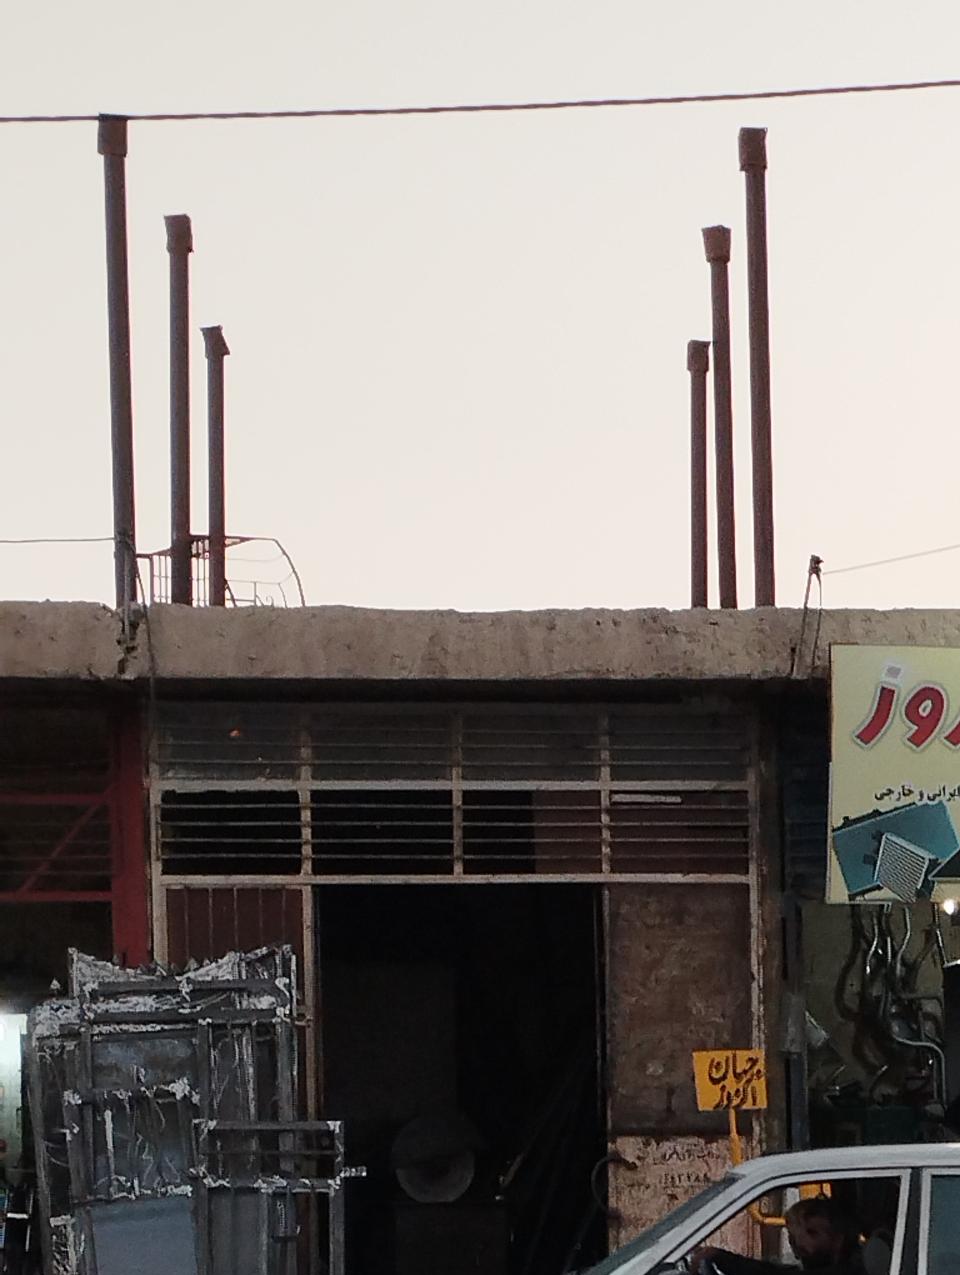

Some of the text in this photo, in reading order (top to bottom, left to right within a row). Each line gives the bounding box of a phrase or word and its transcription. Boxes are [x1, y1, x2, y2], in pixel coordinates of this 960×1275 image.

[874, 784, 914, 802] خارجی
[927, 784, 960, 801] ایرانی
[708, 1051, 763, 1085] جهان
